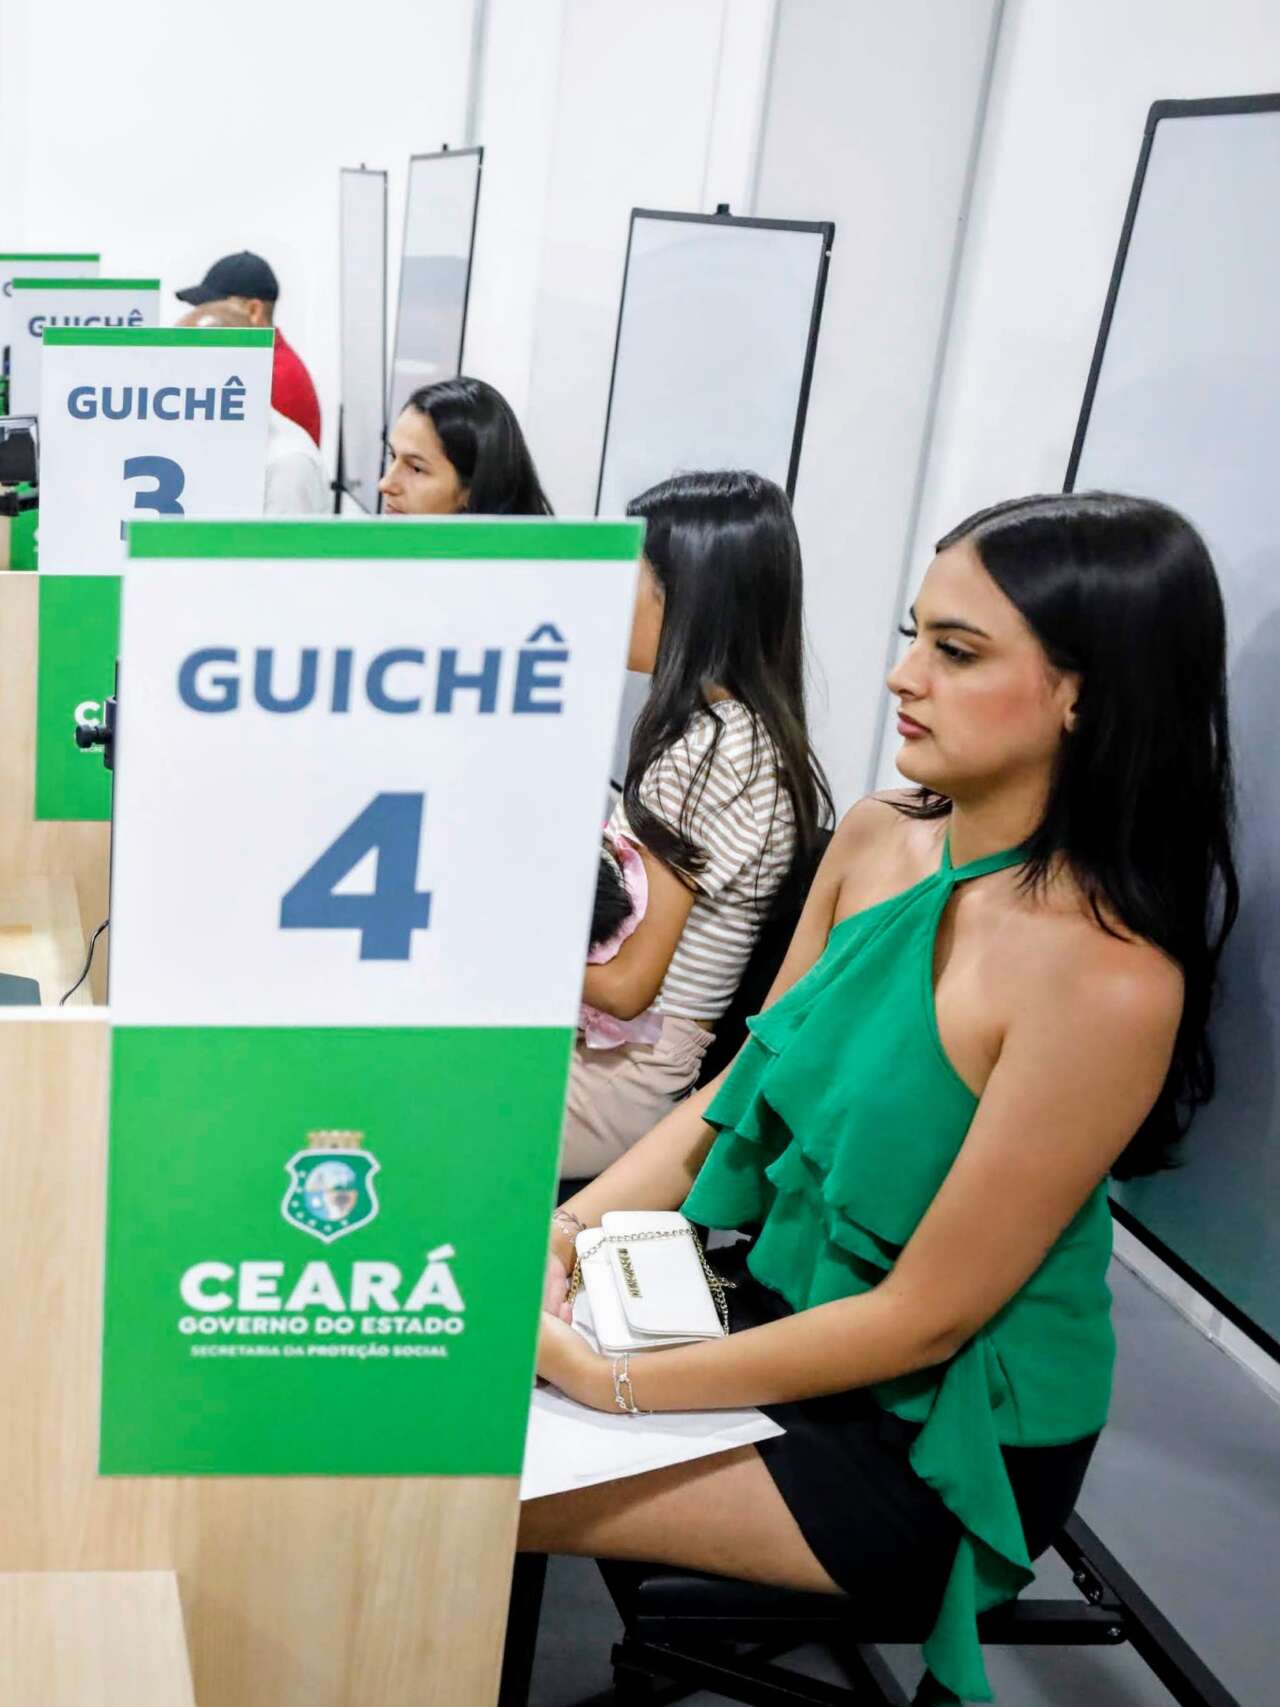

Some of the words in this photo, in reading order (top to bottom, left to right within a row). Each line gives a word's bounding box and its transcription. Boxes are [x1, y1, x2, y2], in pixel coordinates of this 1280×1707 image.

[67, 376, 246, 421] GUICHÊ
[120, 455, 185, 540] 3
[177, 622, 569, 715] GUICHÊ
[279, 791, 432, 961] 4
[179, 1243, 465, 1312] CEARÁ
[178, 1316, 309, 1335] GOVERNO
[315, 1316, 355, 1335] DO
[361, 1316, 465, 1335] ESTADO
[190, 1344, 280, 1357] SECRETARIA
[284, 1344, 305, 1357] DA
[307, 1341, 389, 1359] PROTEÇÃO
[392, 1344, 448, 1357] SOCIAL
